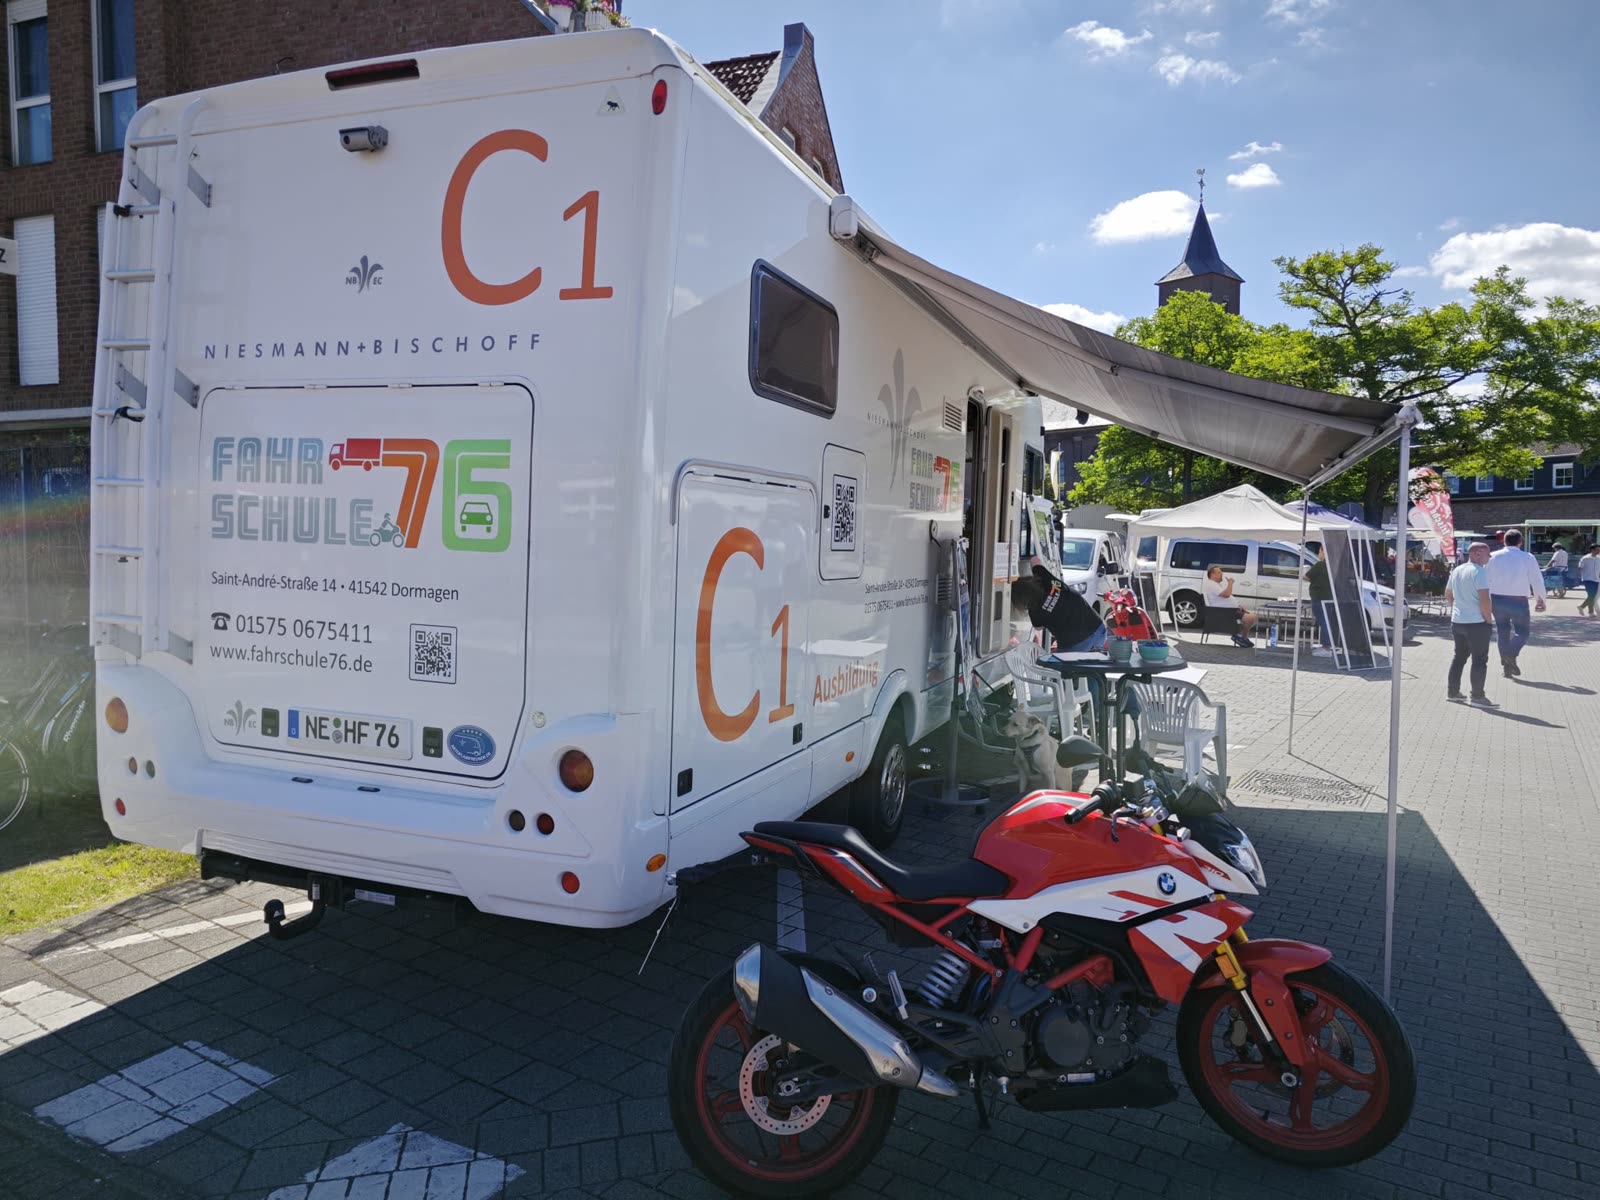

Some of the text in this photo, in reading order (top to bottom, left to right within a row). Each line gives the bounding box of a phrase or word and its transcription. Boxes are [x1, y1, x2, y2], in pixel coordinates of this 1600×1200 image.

[442, 129, 613, 305] C1
[345, 276, 383, 285] NB EC
[204, 334, 540, 359] NIESMANN+BISCHOFF
[212, 437, 324, 485] FAHR
[211, 494, 375, 547] SCHULE
[211, 571, 460, 603] Saint-André-Straße 14 41542 Dormagen
[236, 614, 373, 643] 01575 0675411
[696, 527, 794, 742] C1
[210, 644, 373, 673] www.fahrschule76.de
[813, 660, 879, 705] Ausbildung
[305, 715, 330, 740] NE
[344, 719, 370, 745] HF
[374, 723, 400, 748] 76
